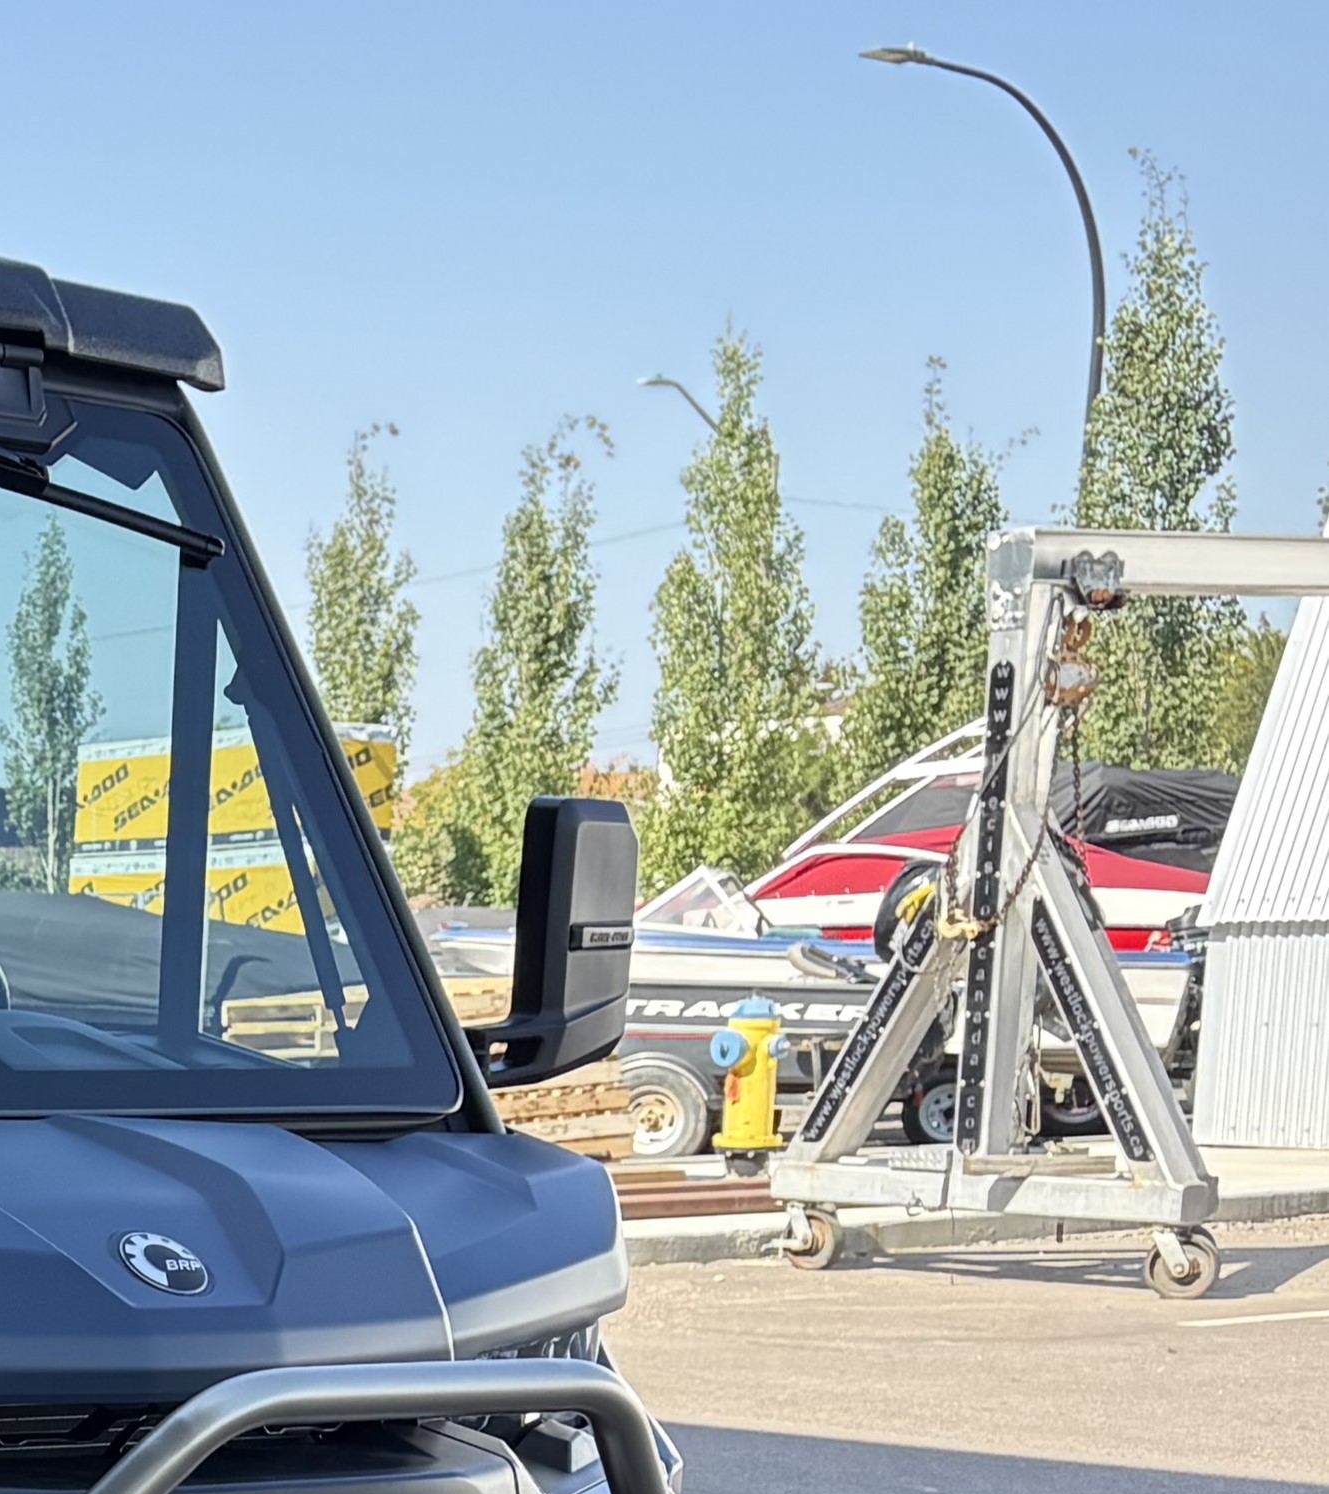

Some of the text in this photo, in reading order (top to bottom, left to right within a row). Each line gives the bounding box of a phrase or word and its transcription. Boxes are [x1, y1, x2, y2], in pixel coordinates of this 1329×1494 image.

[961, 666, 1011, 1150] www.precisiocanada.com
[806, 917, 935, 1140] www.westlockpowersprts.ca
[165, 1259, 202, 1271] BRP
